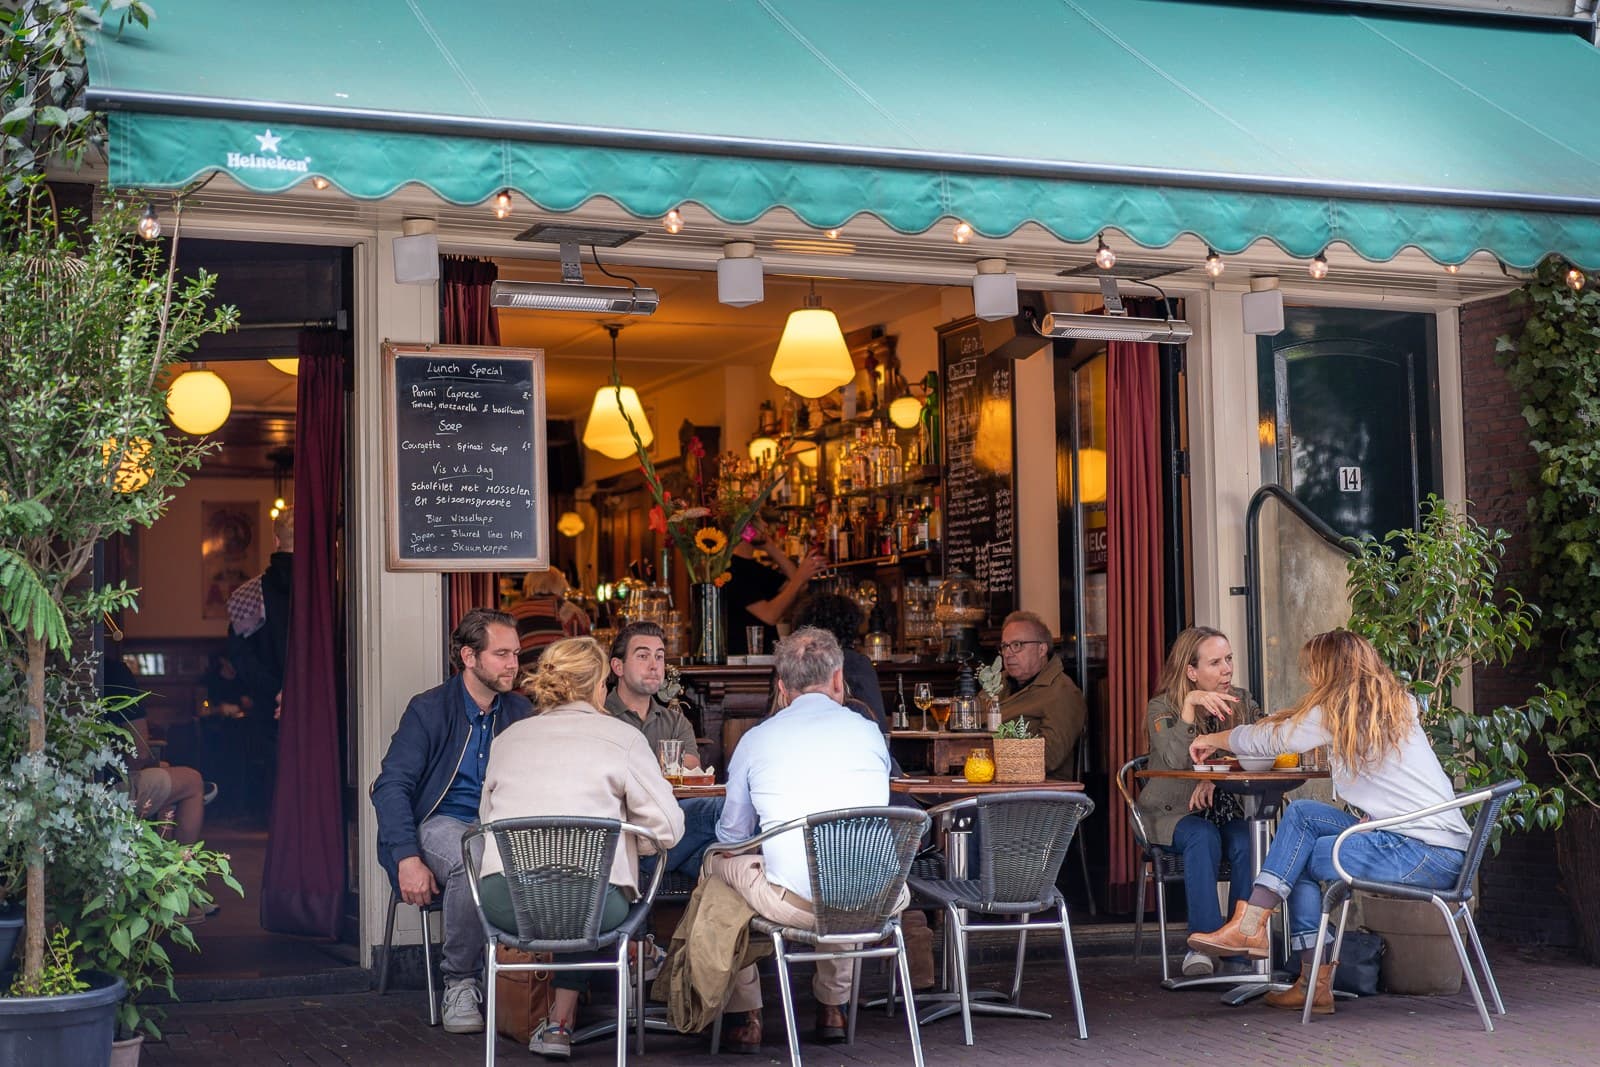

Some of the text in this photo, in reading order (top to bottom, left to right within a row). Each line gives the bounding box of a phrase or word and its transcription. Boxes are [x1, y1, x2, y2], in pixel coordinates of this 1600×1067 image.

[227, 152, 309, 172] Heineken
[427, 362, 503, 378] Lunch Special
[412, 385, 437, 398] Panini
[446, 386, 482, 401] Caprese
[438, 420, 463, 433] Soep
[401, 440, 441, 454] Courgette
[490, 443, 509, 455] Soep
[433, 461, 447, 475] Vis
[476, 464, 494, 480] dag
[1342, 468, 1359, 490] 14
